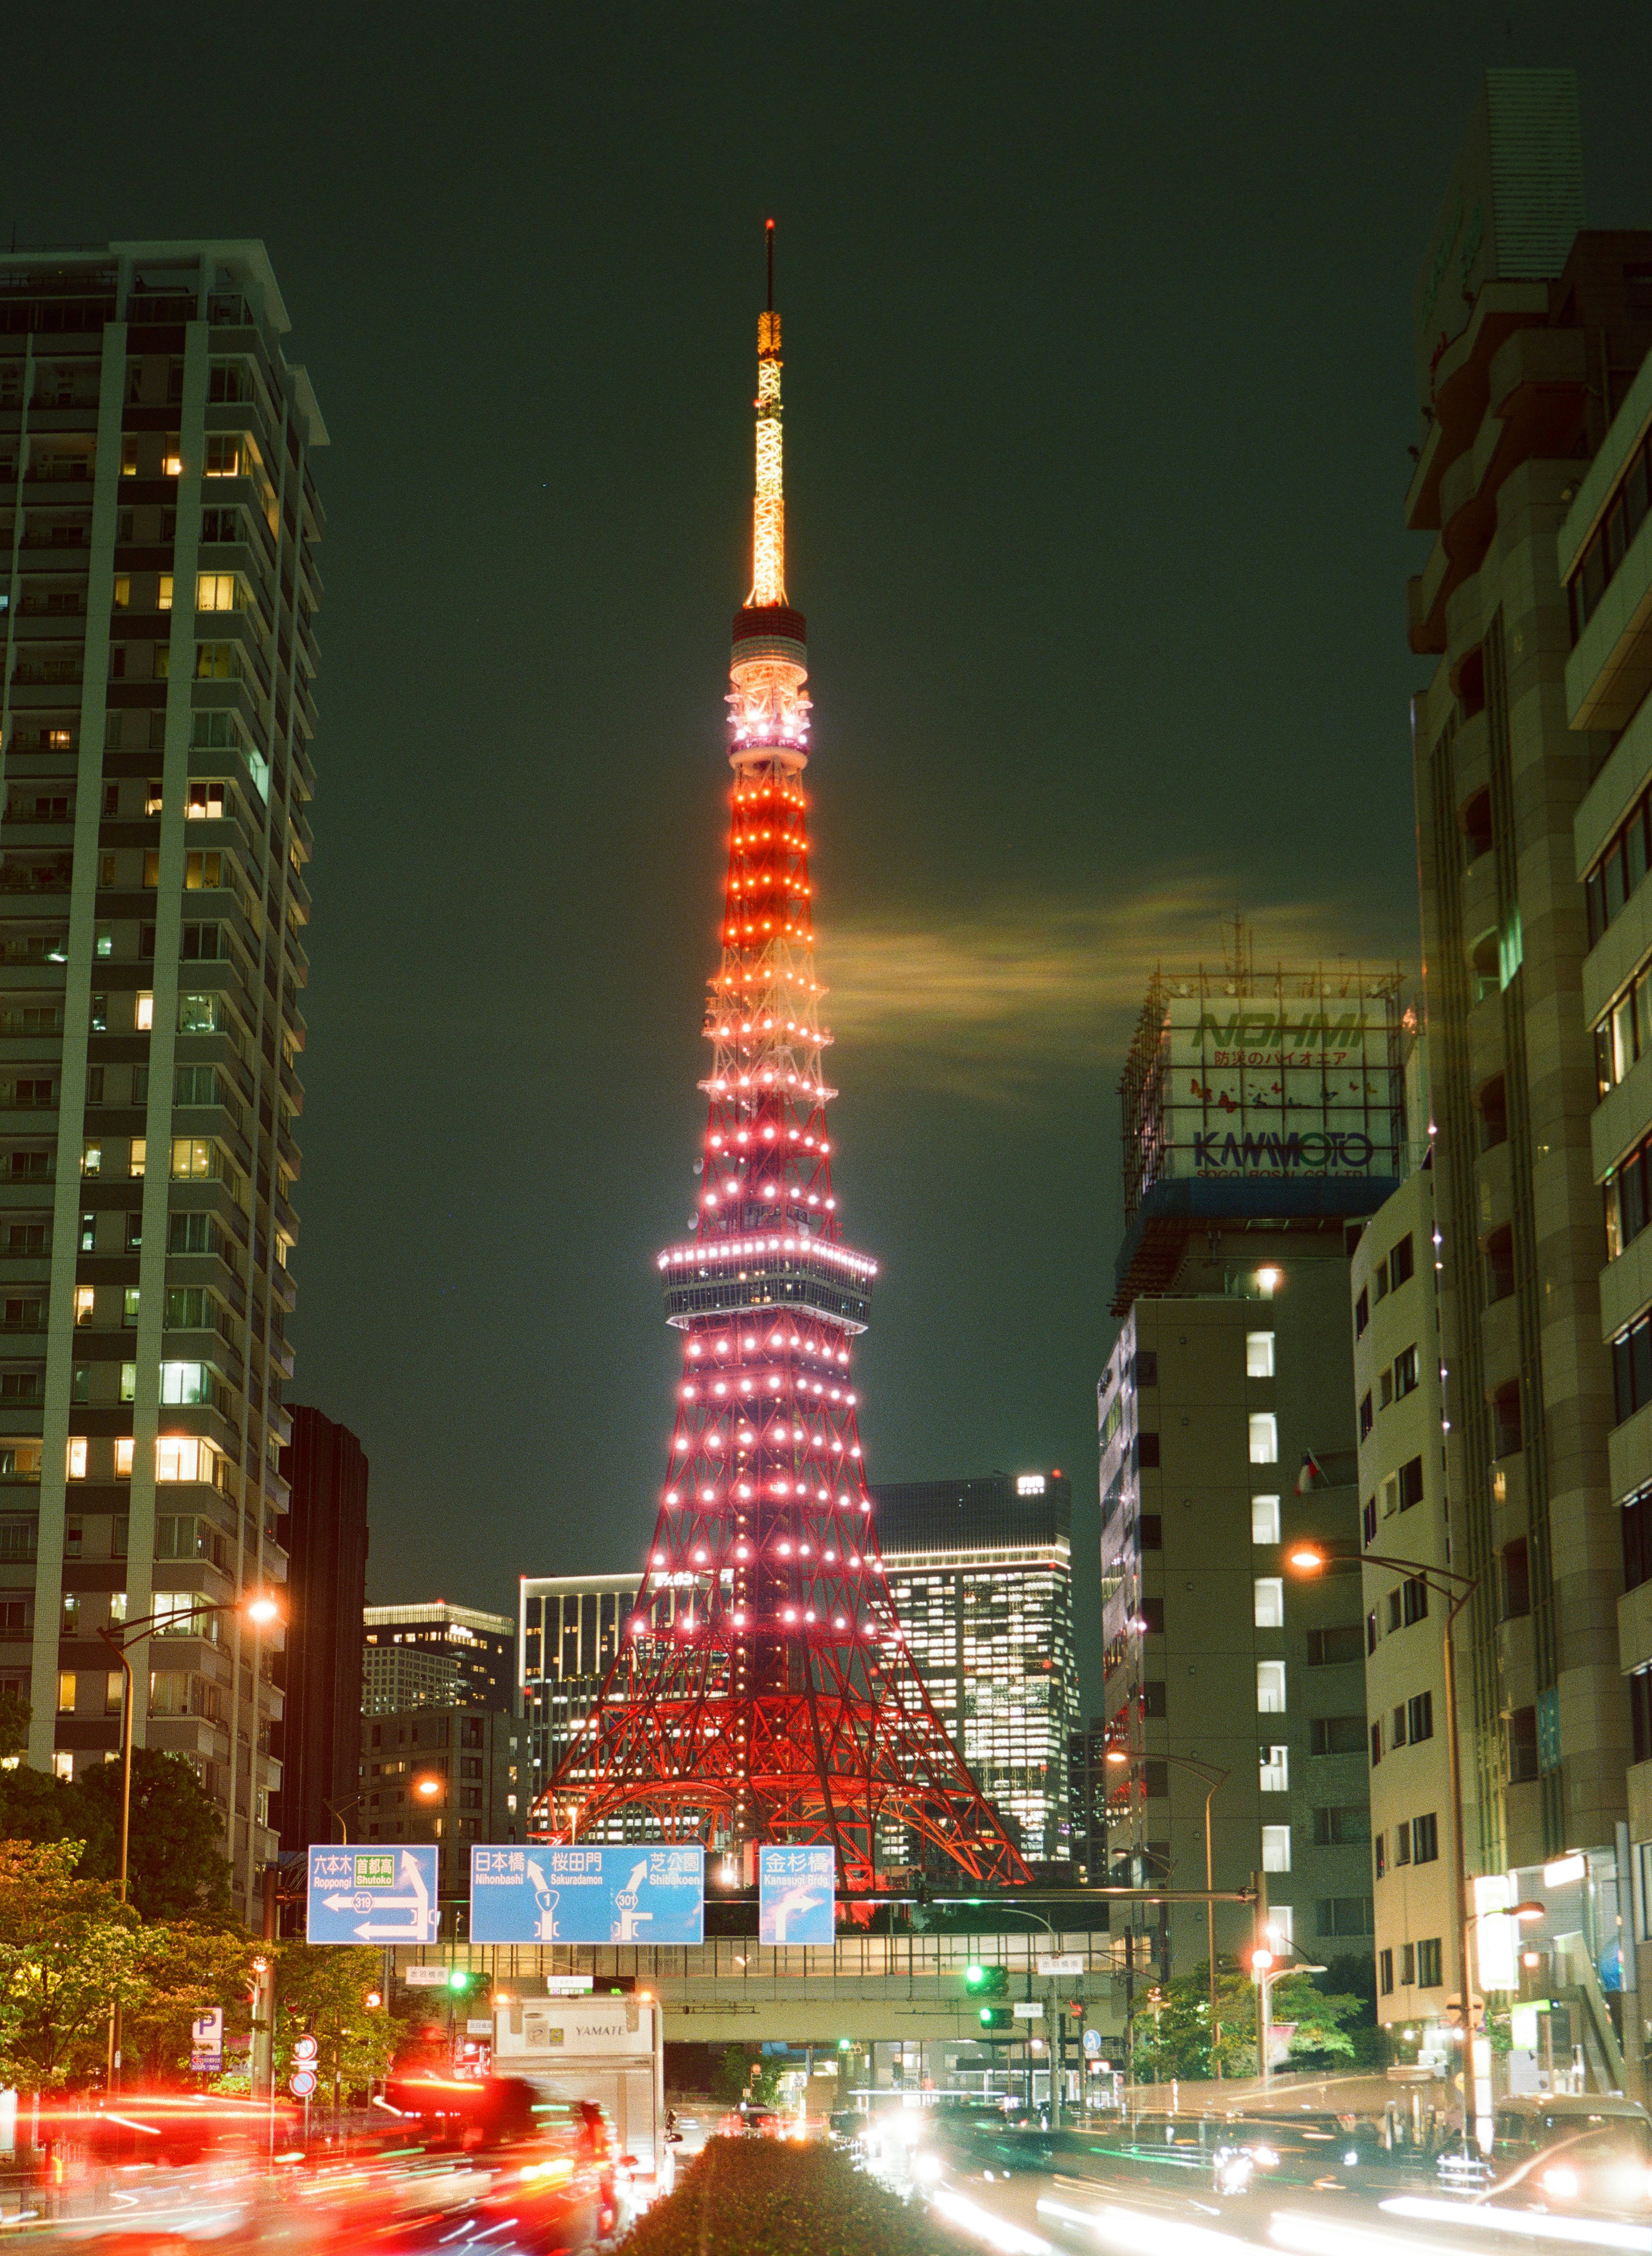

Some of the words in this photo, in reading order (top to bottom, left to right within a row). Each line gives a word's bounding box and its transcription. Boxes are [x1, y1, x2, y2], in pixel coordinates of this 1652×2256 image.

[1192, 1013, 1369, 1047] NOHMI
[314, 1854, 352, 1875] 六本木
[357, 1858, 392, 1874] 首都高
[475, 1852, 524, 1872] 日本橋
[551, 1852, 602, 1872] 桜田門
[649, 1852, 699, 1872] 芝公園
[765, 1852, 828, 1872] 金杉橋
[314, 1877, 351, 1889] Roppongi
[357, 1876, 392, 1885] Shutoko
[475, 1874, 523, 1885] Nihonbashi
[551, 1874, 603, 1885] Sakuradamon
[649, 1873, 700, 1886] Shibakoen
[764, 1875, 805, 1887] Kanasugi
[356, 1898, 371, 1908] 319
[544, 1894, 550, 1907] 1
[619, 1894, 635, 1906] 301
[575, 2026, 626, 2035] YAMATE
